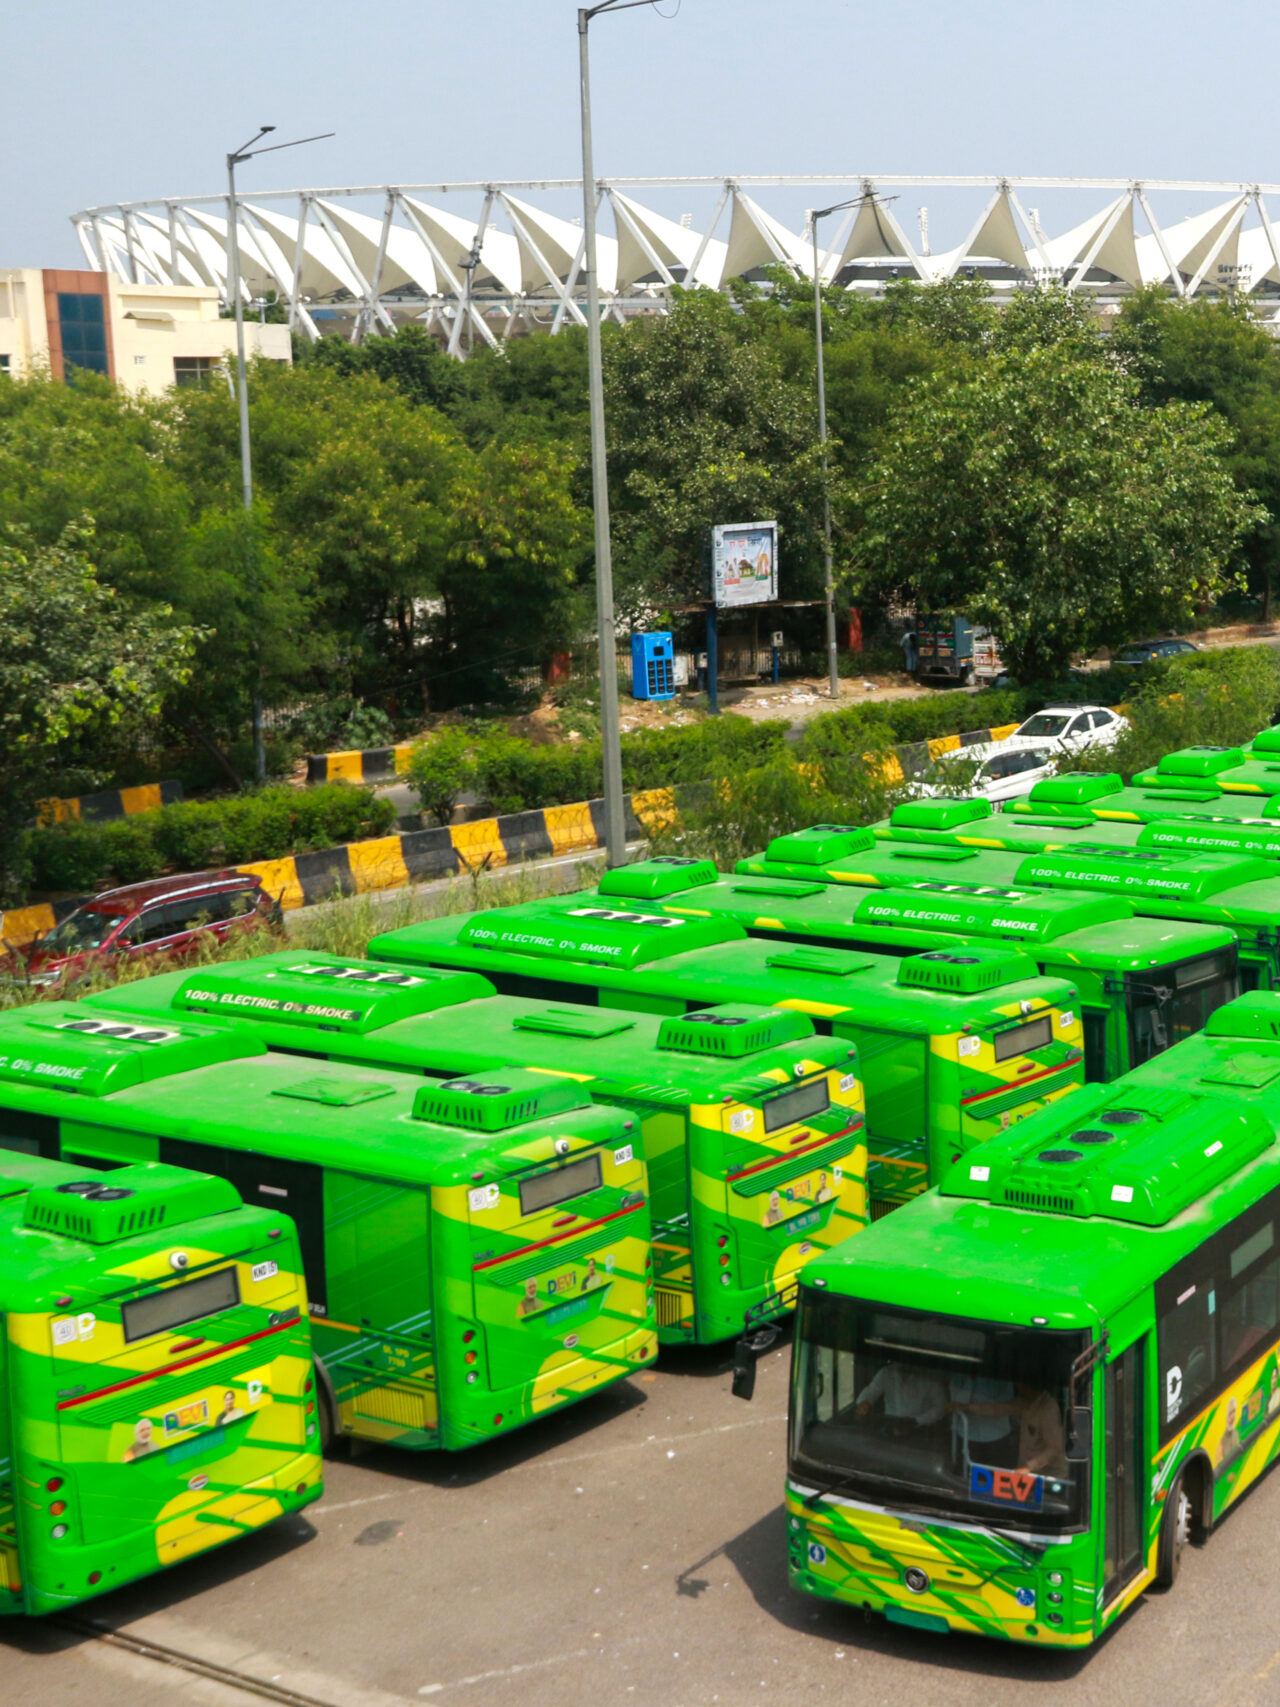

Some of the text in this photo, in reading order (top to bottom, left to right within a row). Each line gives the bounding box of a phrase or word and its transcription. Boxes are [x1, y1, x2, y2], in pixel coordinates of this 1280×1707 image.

[1152, 833, 1184, 843] 100%
[1185, 835, 1241, 848] ELECTRIC.
[1245, 841, 1264, 850] 0%
[1029, 867, 1192, 891] 100% ELECTRIC. 0% SMOKE.
[867, 905, 1039, 932] 100% ELECTRIC. 0% SMOKE.
[468, 927, 499, 941] 100%
[558, 939, 577, 950] 0%
[184, 988, 354, 1021] 100% ELECTRIC. 0% SMOKE.
[11, 1058, 34, 1073] 0%
[33, 1062, 86, 1082] SMOKE.
